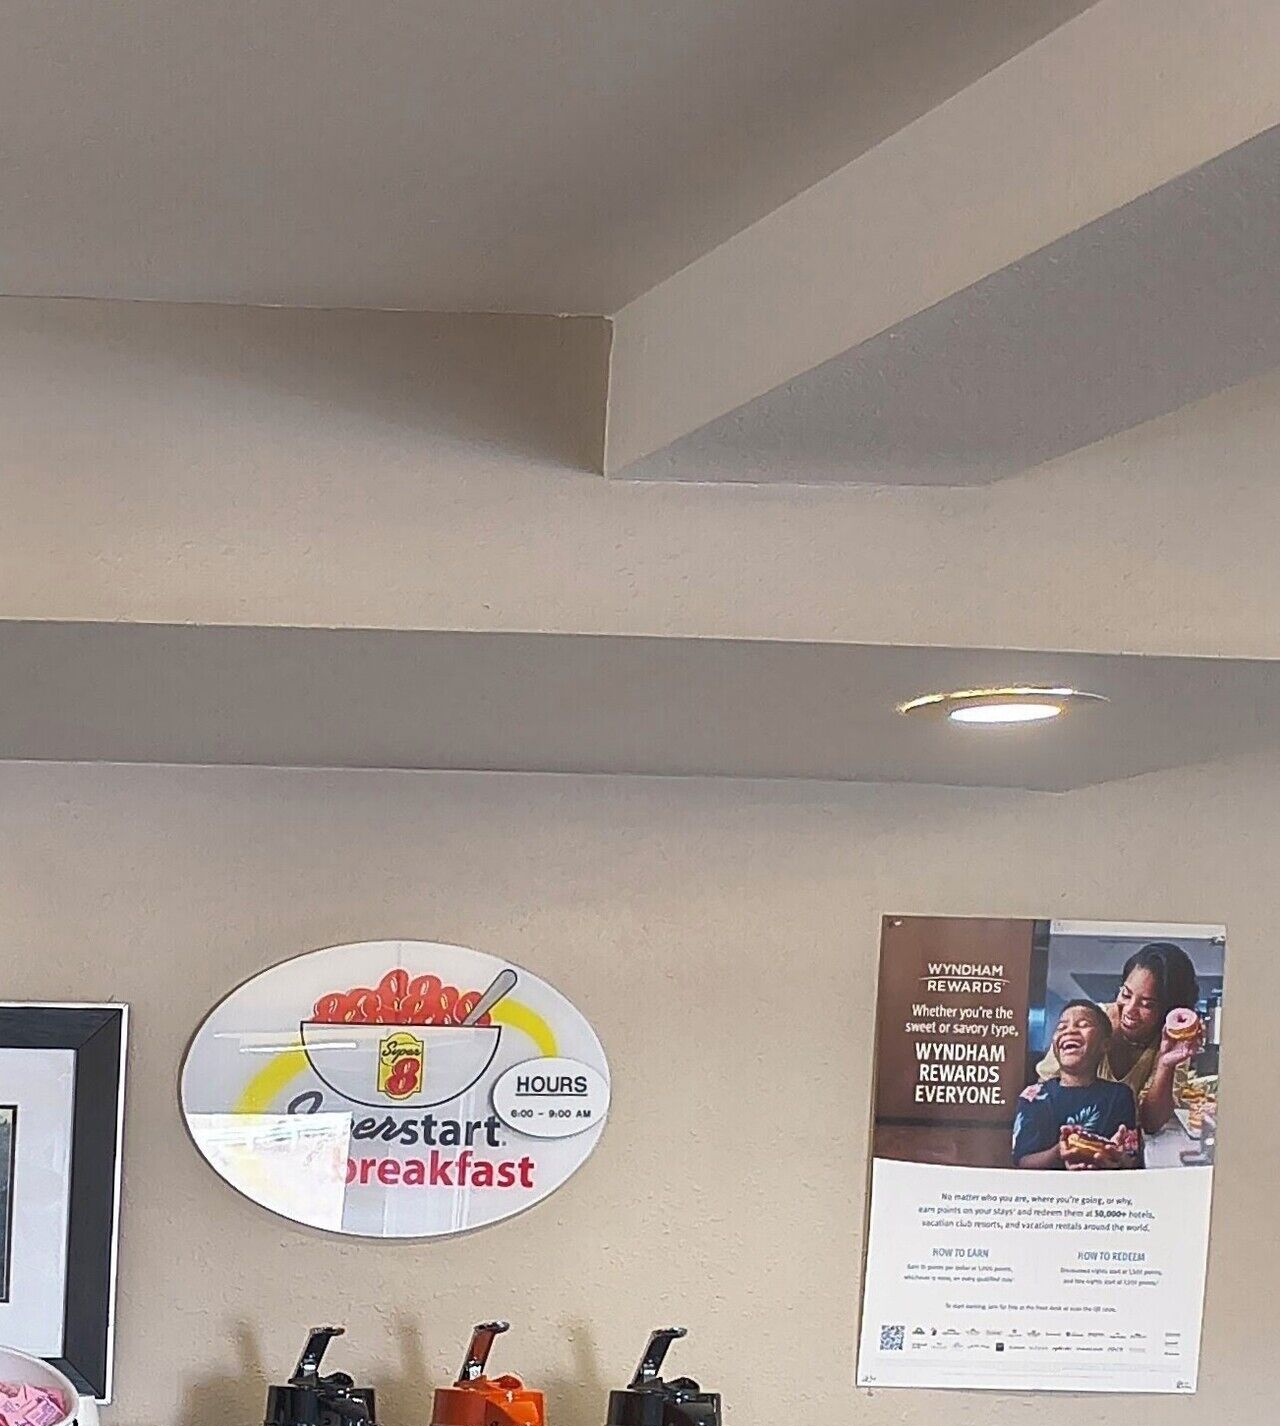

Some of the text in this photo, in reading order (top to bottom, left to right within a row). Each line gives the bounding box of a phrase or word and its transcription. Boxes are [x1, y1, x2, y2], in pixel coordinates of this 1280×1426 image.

[928, 963, 1003, 976] WYNDHAM
[927, 980, 1002, 993] REWARDS
[912, 1004, 1013, 1020] Whether you're the
[905, 1022, 1019, 1037] sweet or savory type,
[382, 1041, 422, 1063] Super
[916, 1042, 1005, 1062] WYNDHAM
[385, 1058, 420, 1095] 8
[920, 1064, 999, 1083] REWARDS
[517, 1076, 587, 1092] HOURS
[915, 1085, 1005, 1104] EVERYONE.
[511, 1110, 533, 1118] 6:00
[549, 1110, 571, 1118] 9:00
[576, 1110, 591, 1118] AM
[1056, 1196, 1079, 1204] you're
[1081, 1197, 1105, 1205] going,
[1095, 1210, 1126, 1218] 50,000+
[1129, 1211, 1155, 1219] hotels,
[974, 1221, 1003, 1229] resorts,
[1055, 1222, 1081, 1230] rentals
[1084, 1223, 1110, 1231] around
[933, 1248, 989, 1258] HOW TO EARN
[1078, 1252, 1145, 1261] HOW TO REDEEM
